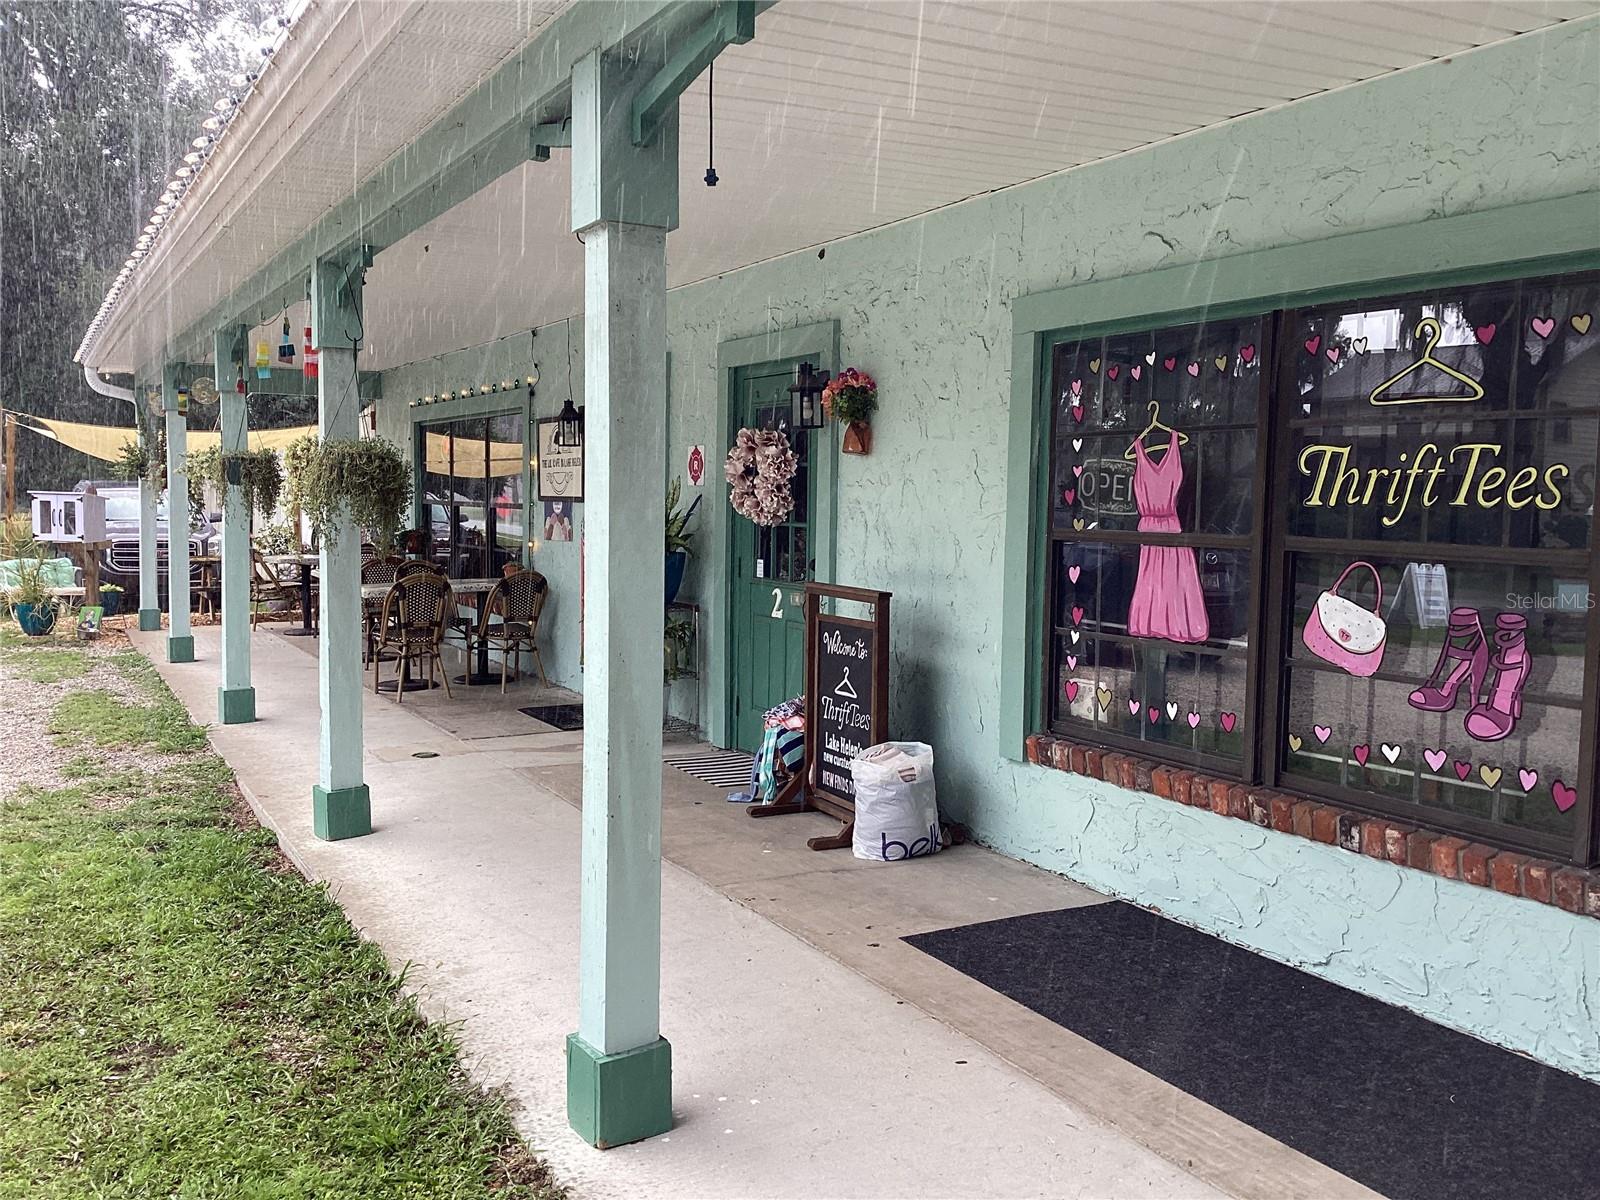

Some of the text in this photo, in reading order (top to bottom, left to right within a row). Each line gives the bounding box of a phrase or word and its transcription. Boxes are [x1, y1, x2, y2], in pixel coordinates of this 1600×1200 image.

[1081, 471, 1136, 503] OPE
[1297, 443, 1570, 527] Thrift Tees
[771, 588, 784, 618] 2
[823, 630, 857, 656] Welcome
[821, 695, 871, 731] Thrift Tees
[825, 731, 840, 752] Lake
[823, 751, 834, 764] new
[822, 769, 834, 788] NEW
[834, 774, 849, 794] FINDS
